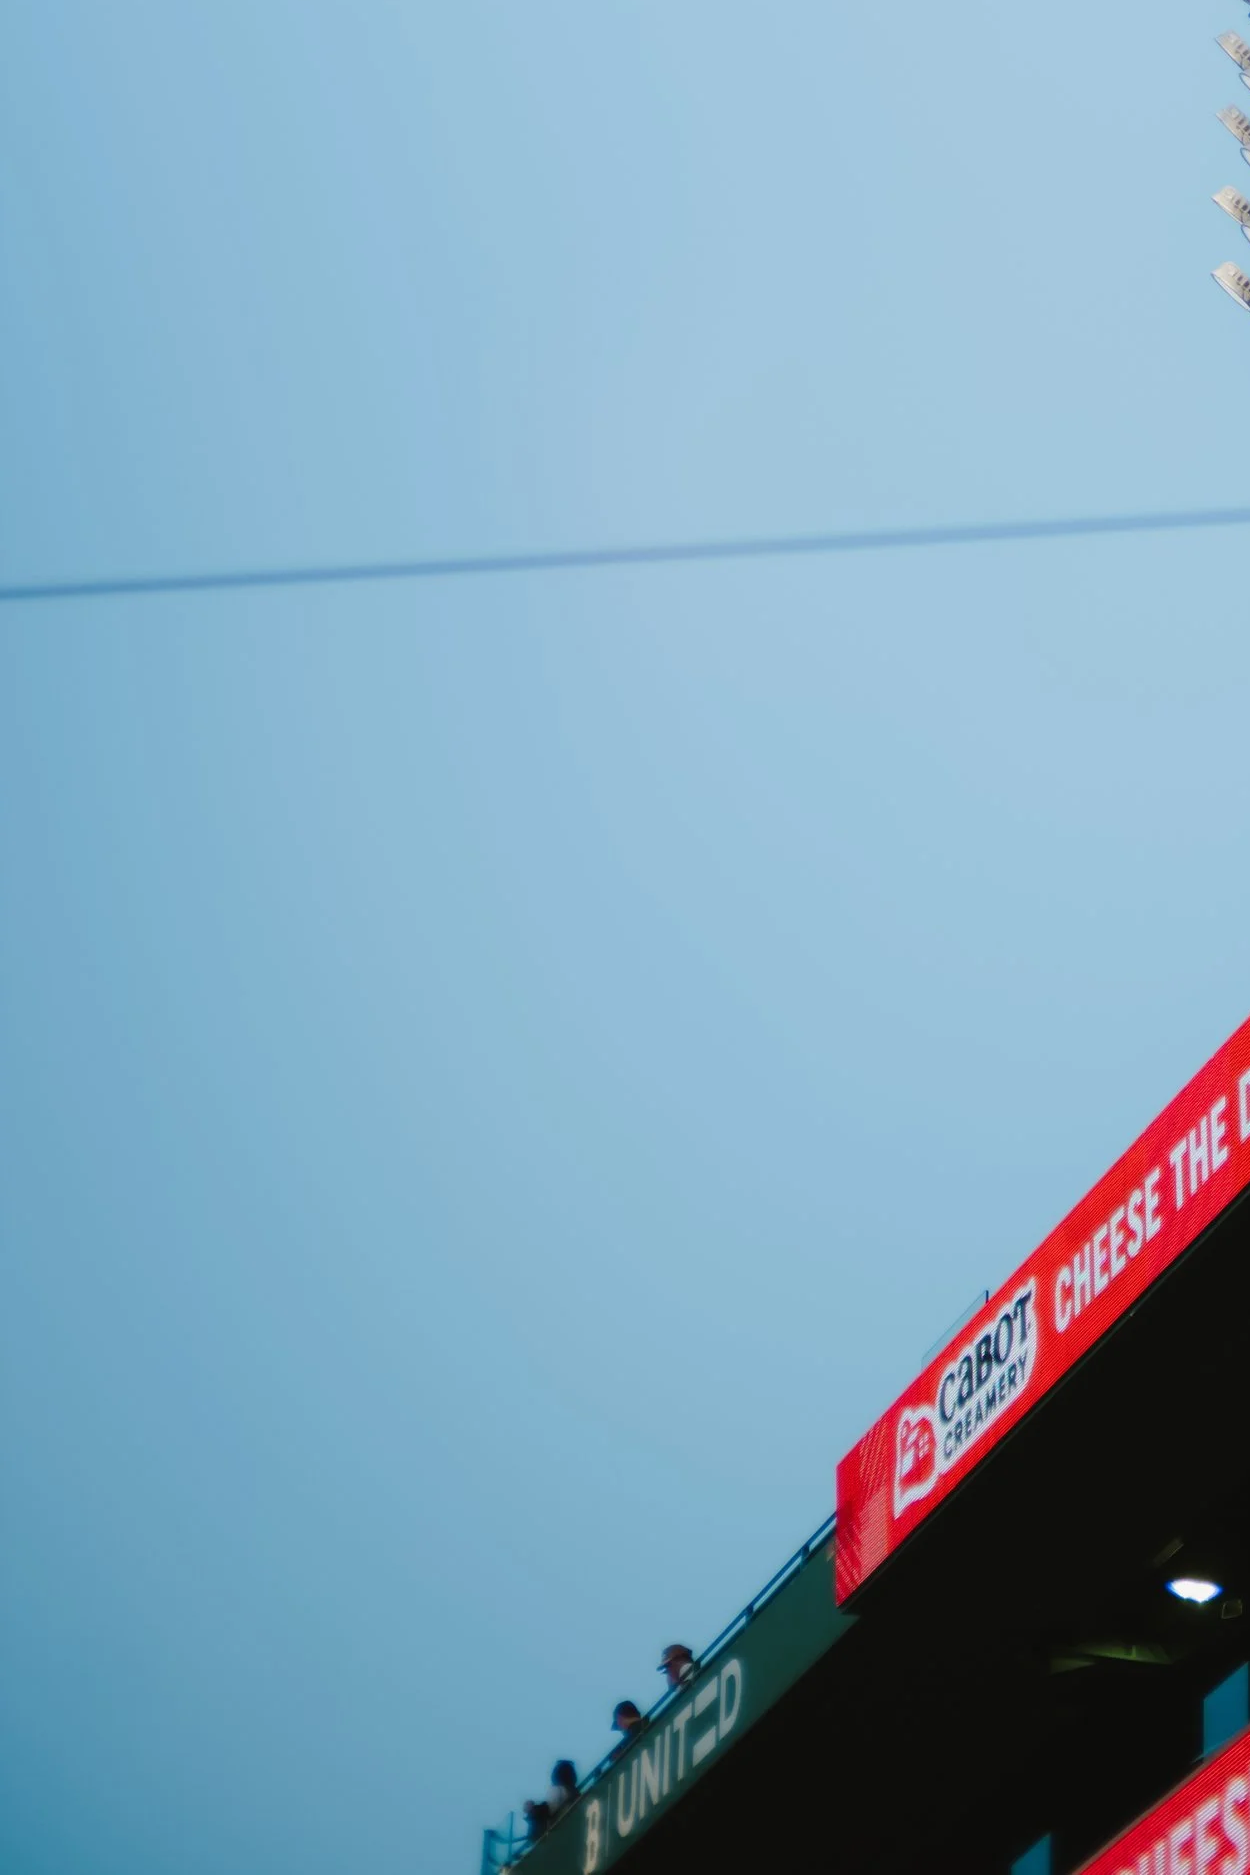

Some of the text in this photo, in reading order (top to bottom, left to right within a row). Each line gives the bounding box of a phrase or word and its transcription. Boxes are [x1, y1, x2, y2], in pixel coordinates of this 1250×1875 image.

[1053, 1166, 1162, 1335] CHEESE
[1169, 1095, 1229, 1210] THE
[943, 1349, 1028, 1461] CREAMERY
